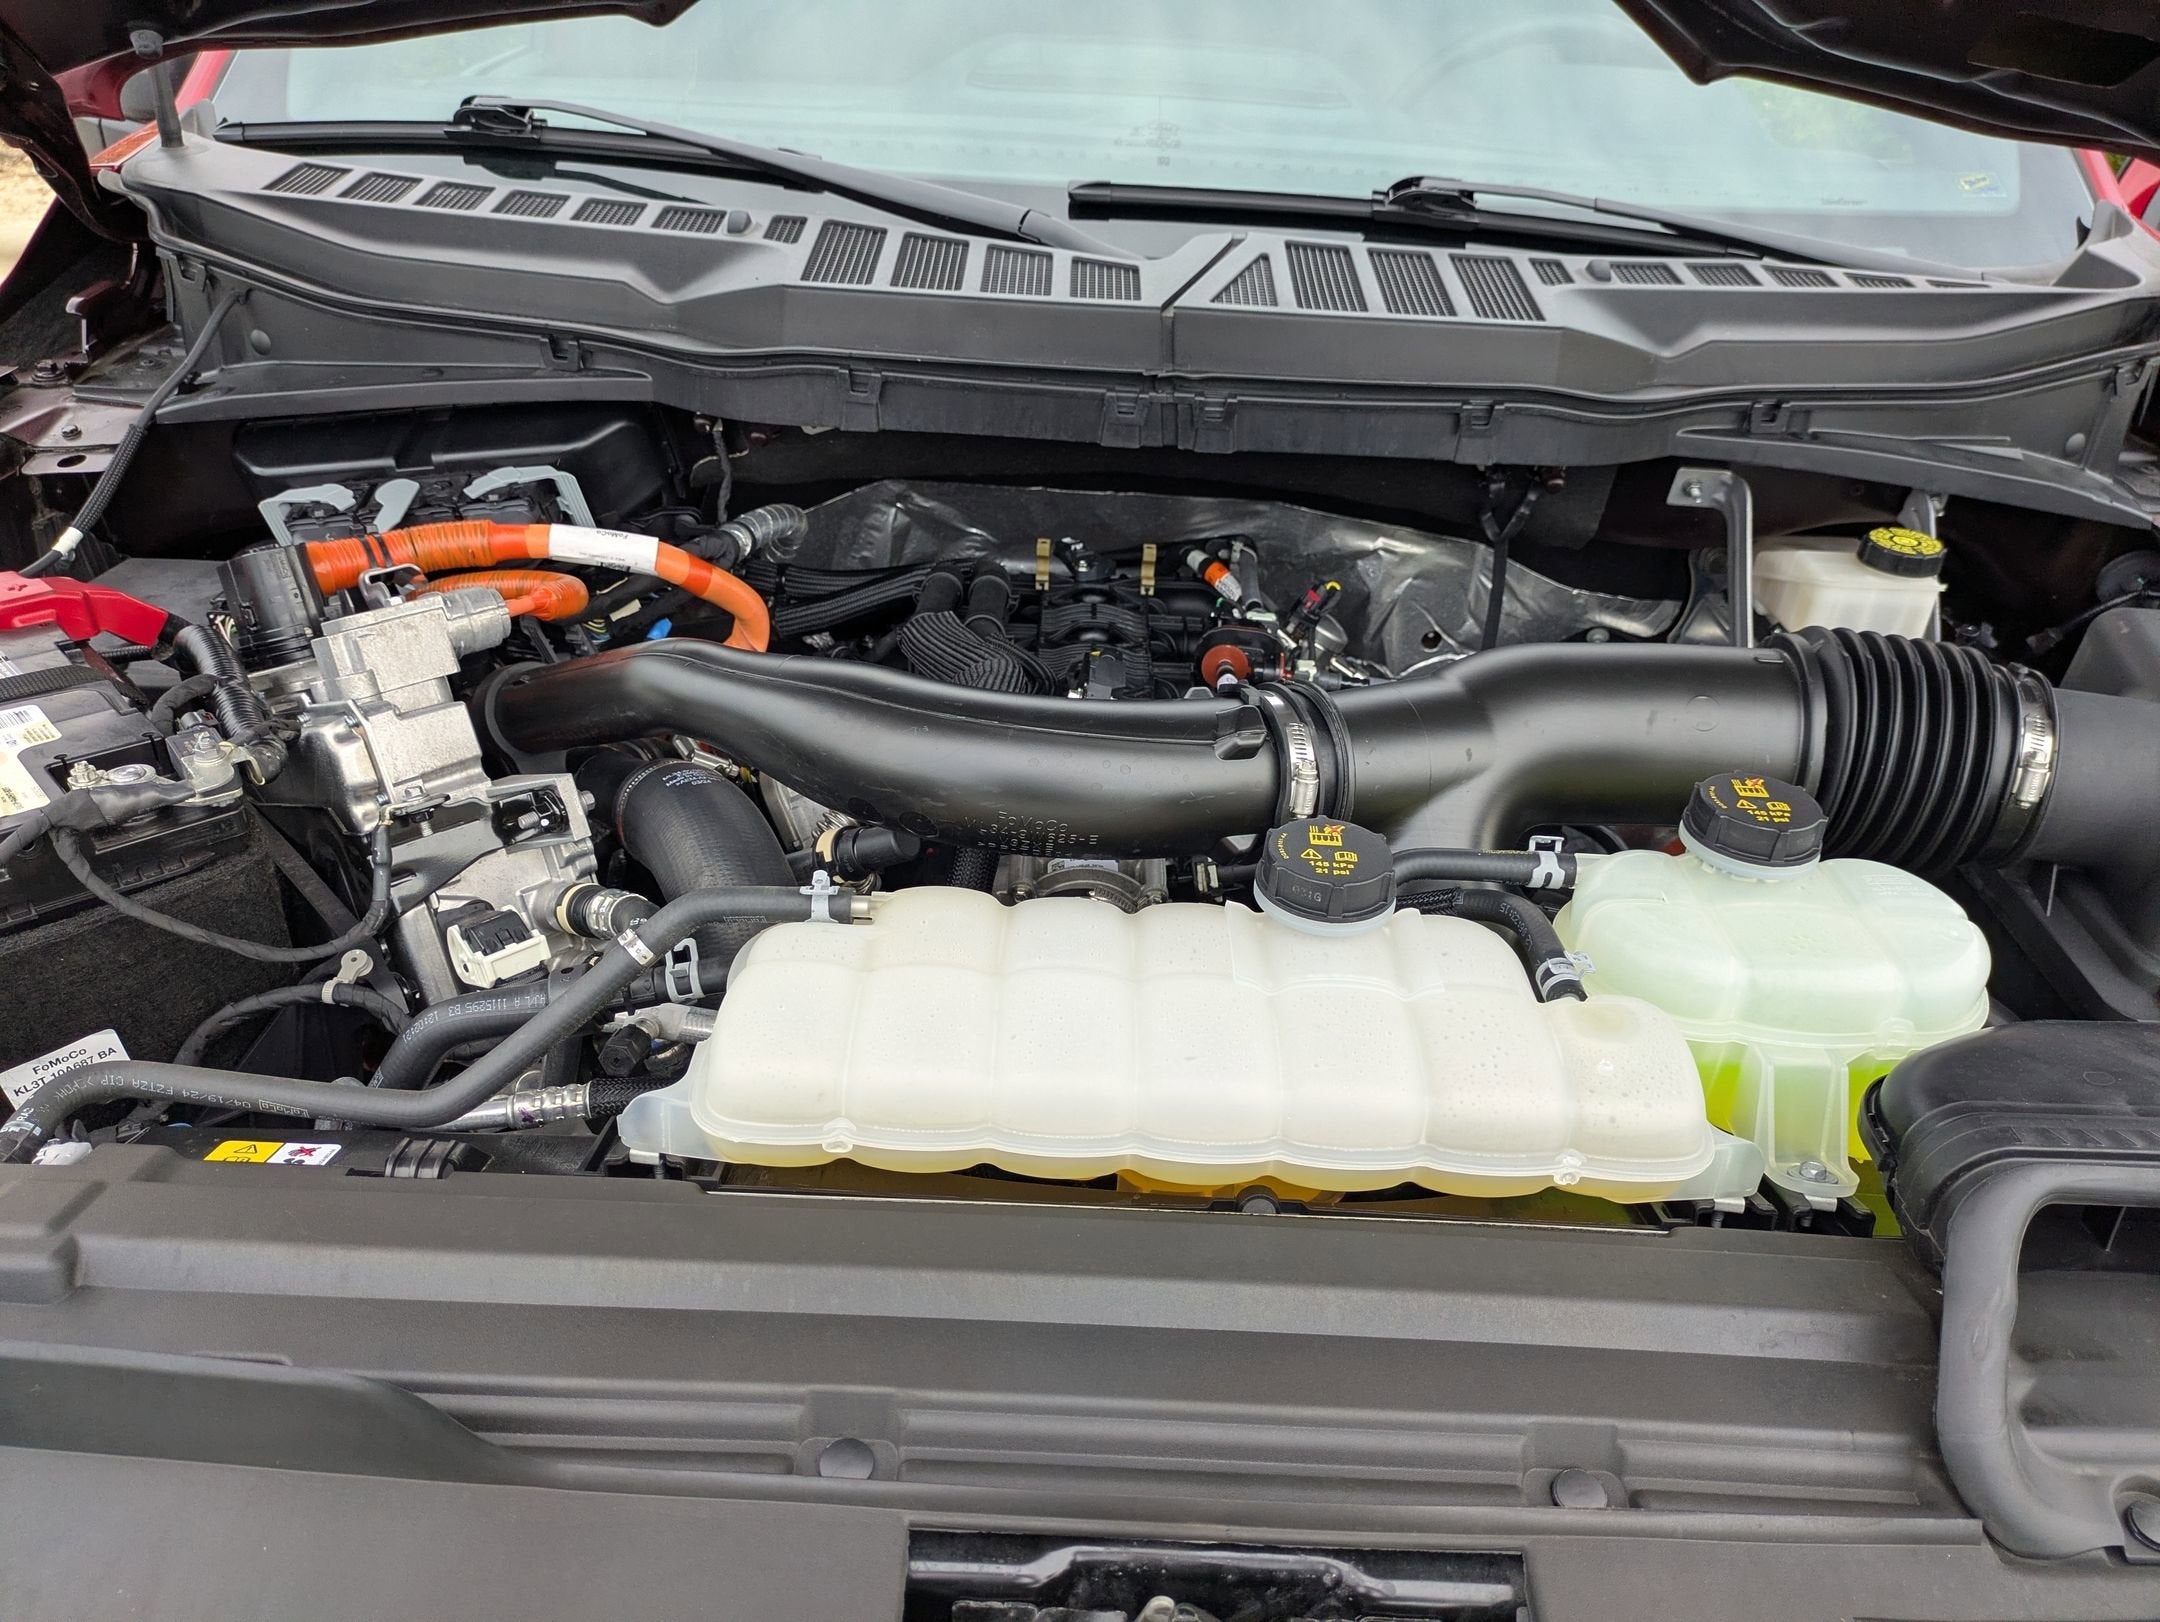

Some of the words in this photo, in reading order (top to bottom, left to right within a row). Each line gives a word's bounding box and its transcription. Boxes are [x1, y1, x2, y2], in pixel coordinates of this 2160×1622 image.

[1308, 860, 1330, 868] 145
[1315, 867, 1329, 875] 21
[32, 1048, 87, 1075] FoMoCo
[13, 1076, 46, 1097] KL3T
[97, 1047, 117, 1060] BA
